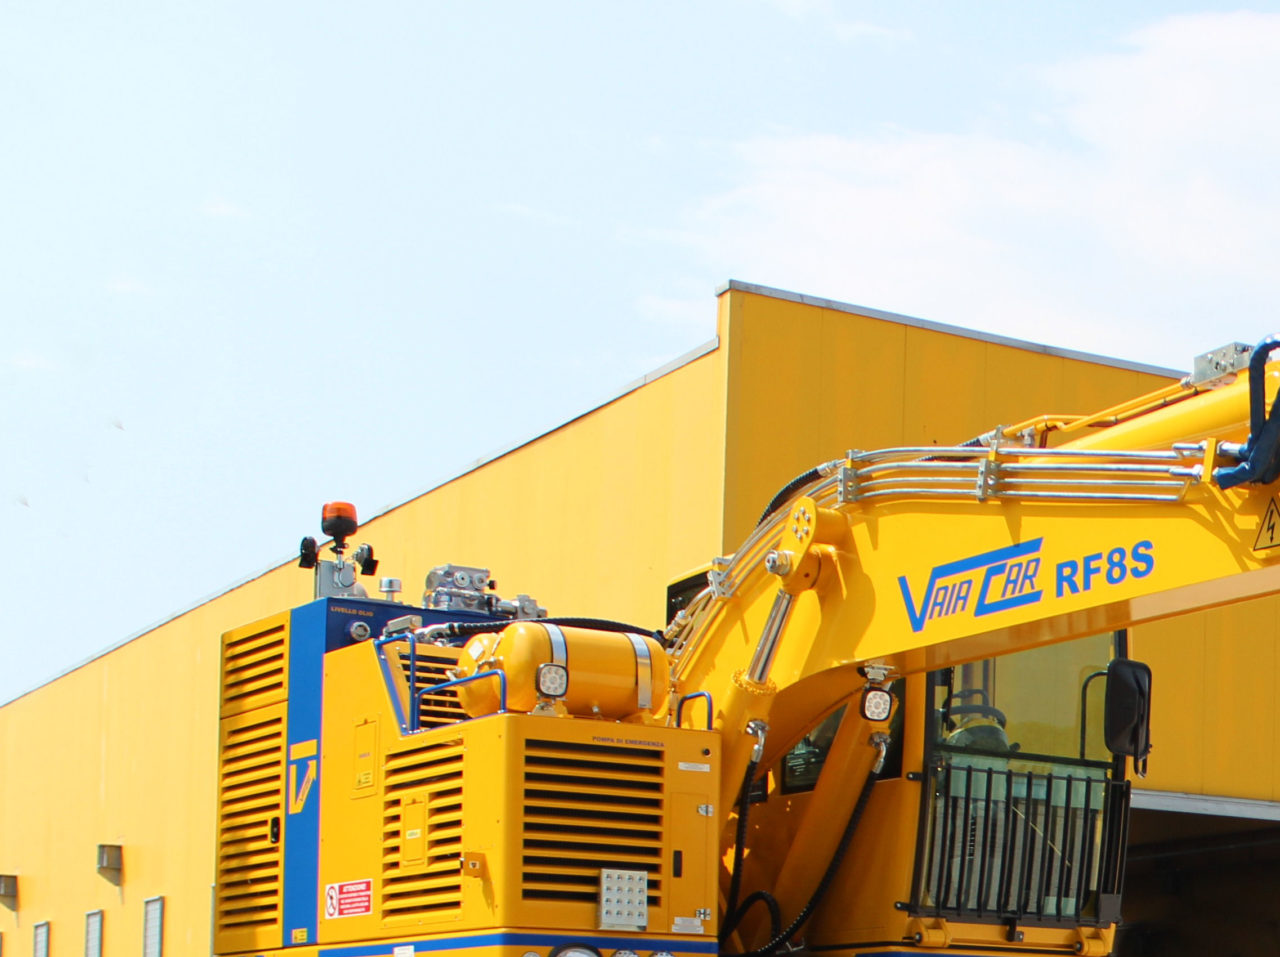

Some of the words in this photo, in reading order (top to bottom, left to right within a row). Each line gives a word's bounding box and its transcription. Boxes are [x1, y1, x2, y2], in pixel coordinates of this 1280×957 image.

[897, 557, 974, 633] VAIA
[974, 540, 1044, 618] CAR
[1055, 539, 1155, 599] RF8S
[330, 606, 357, 615] LIVELLO
[357, 609, 374, 617] OLIO
[592, 735, 615, 743] POMPA
